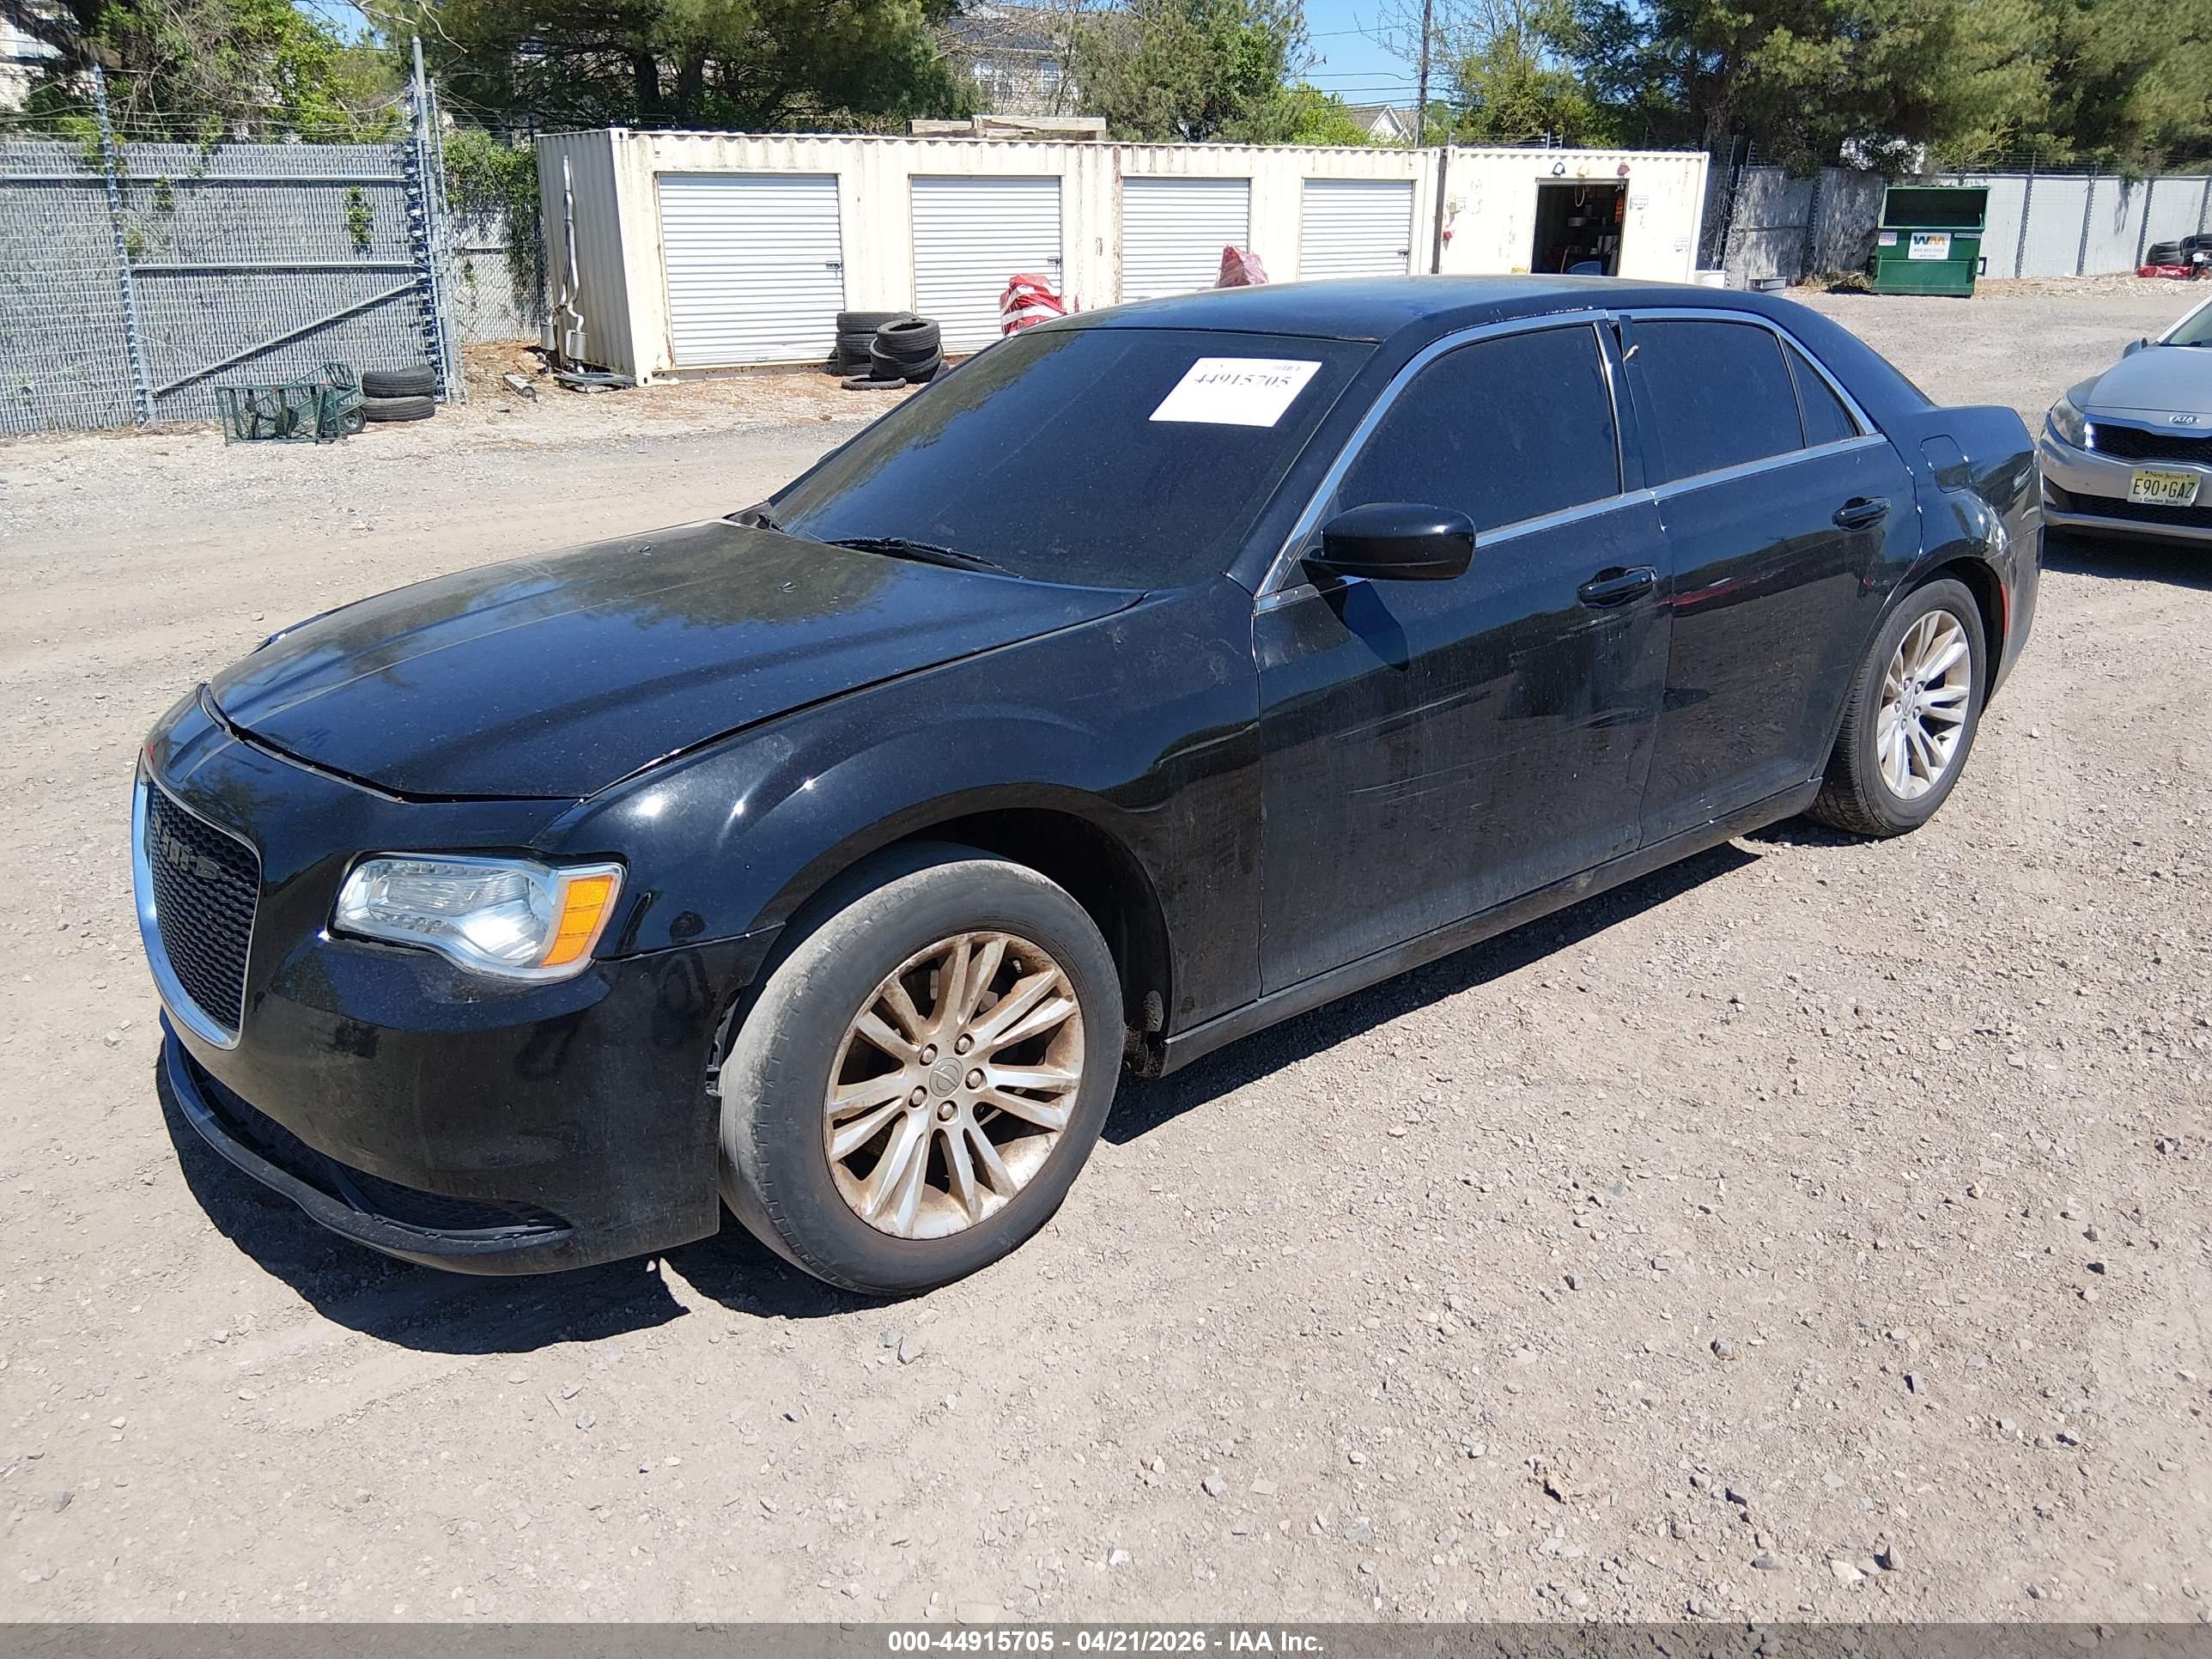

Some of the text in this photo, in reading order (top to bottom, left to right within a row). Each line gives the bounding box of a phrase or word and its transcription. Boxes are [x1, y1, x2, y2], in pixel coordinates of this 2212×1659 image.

[1913, 235, 1946, 246] WM
[1194, 374, 1292, 387] 44915705
[2132, 478, 2196, 499] E90 GAZ
